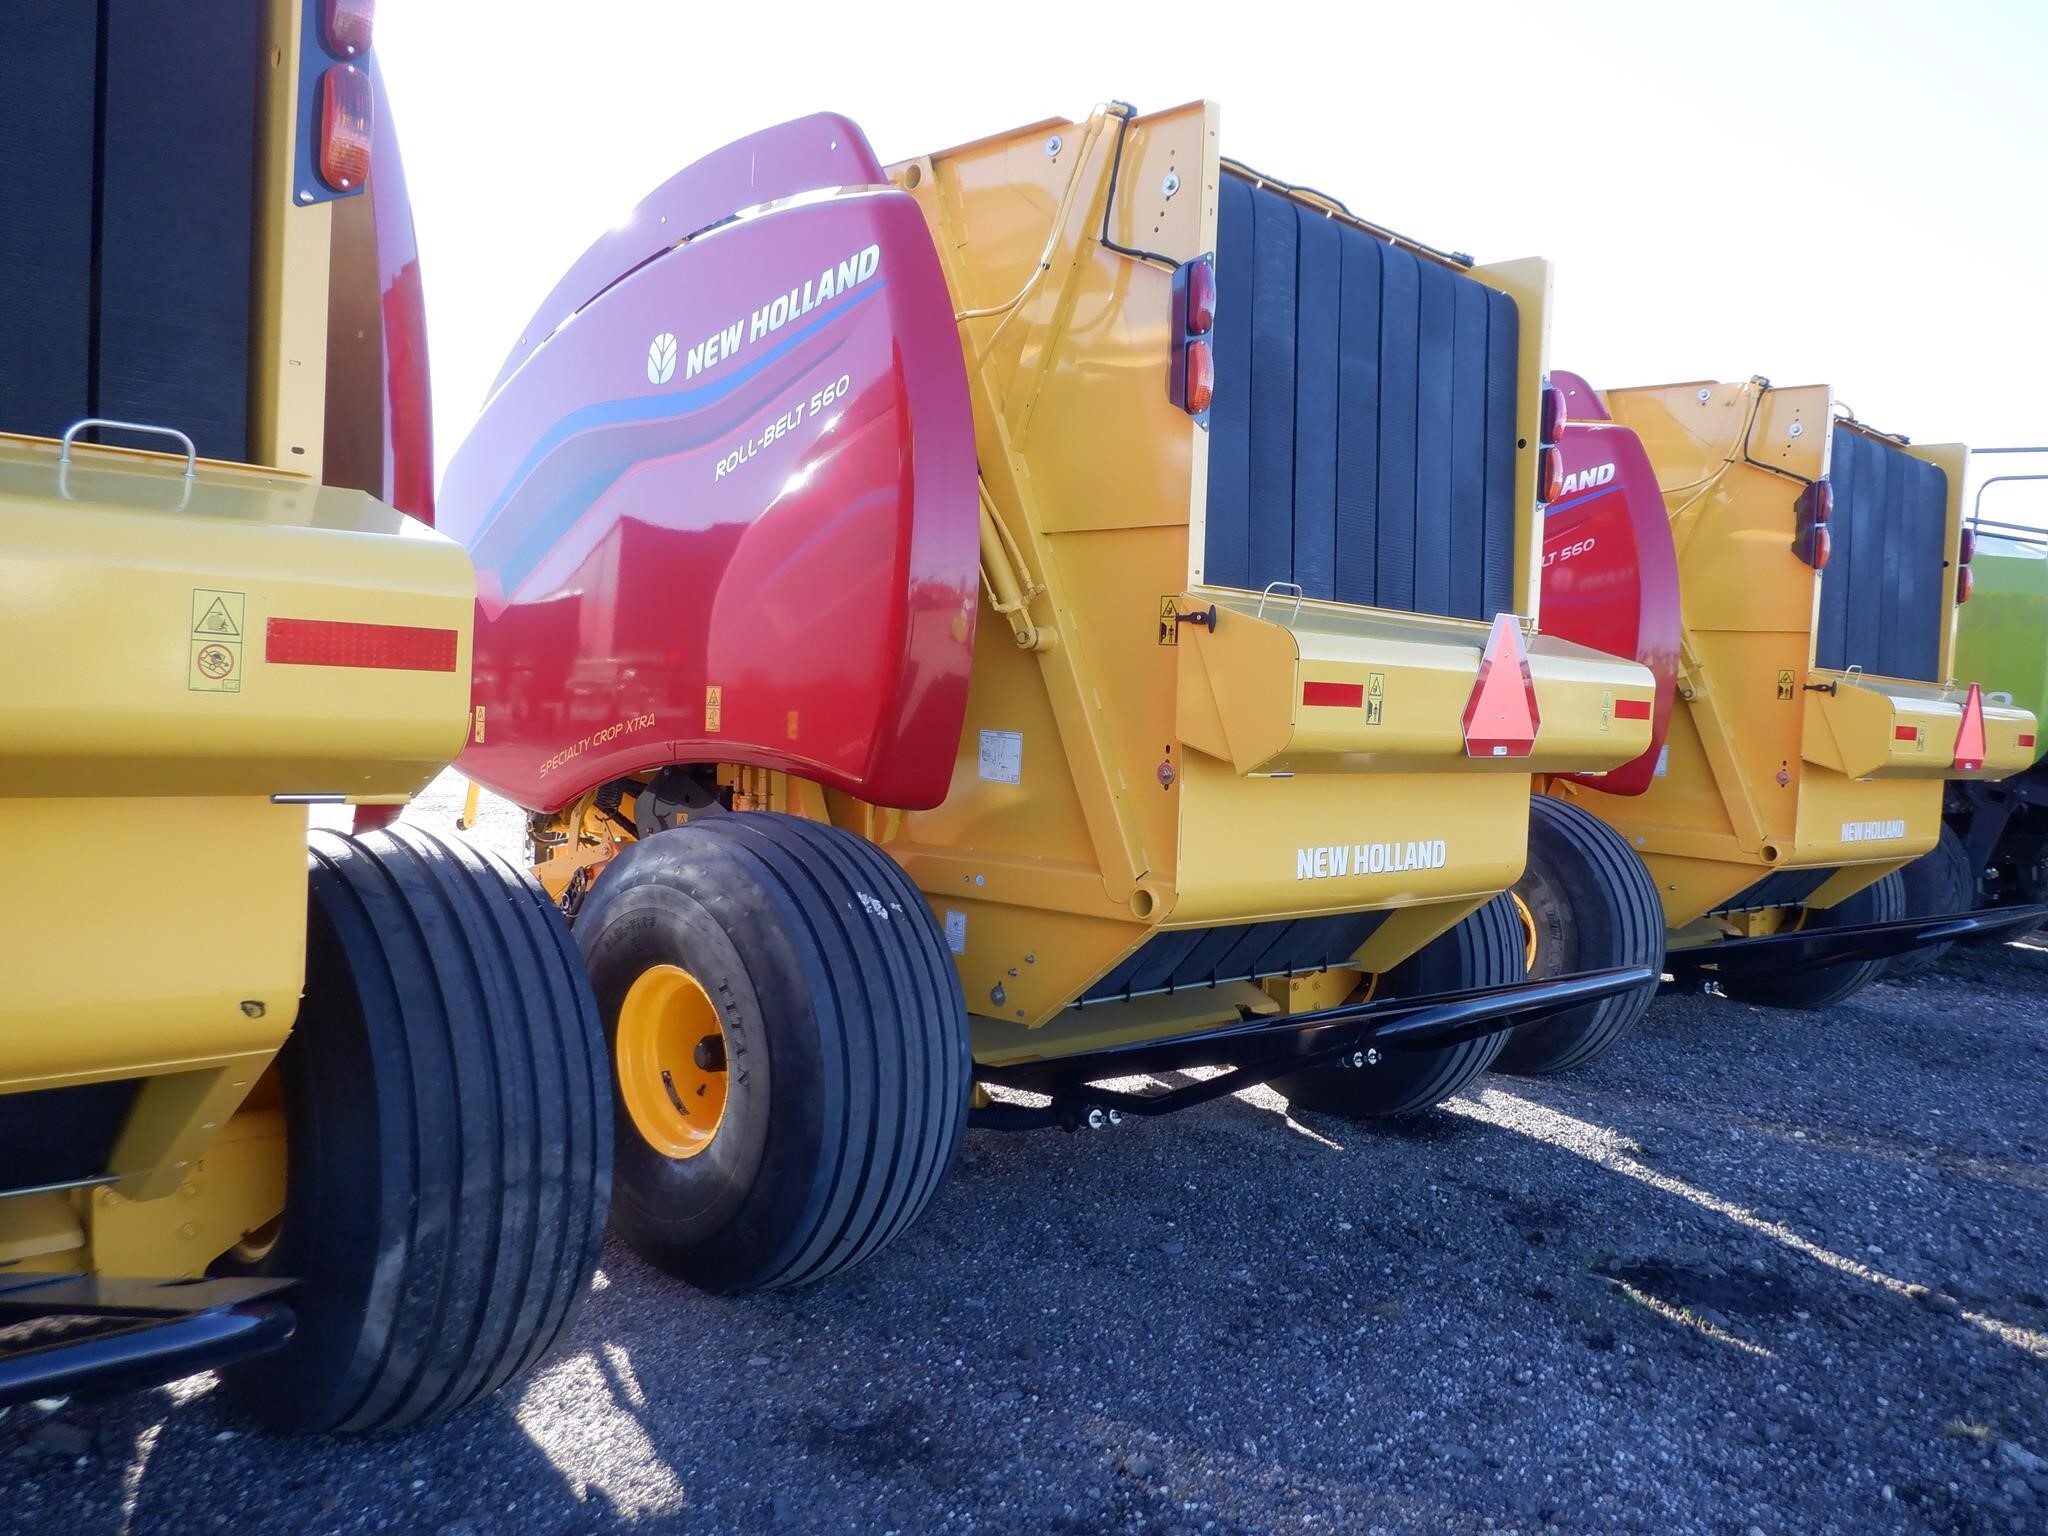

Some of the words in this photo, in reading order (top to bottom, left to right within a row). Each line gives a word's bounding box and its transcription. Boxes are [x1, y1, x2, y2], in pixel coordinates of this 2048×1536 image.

[686, 319, 745, 381] NEW
[749, 244, 881, 345] HOLLAND
[714, 401, 806, 482] ROLL-BELT
[809, 374, 850, 417] 560
[1560, 538, 1595, 561] 560
[540, 736, 591, 778] SPECIALTY
[593, 723, 624, 746] CROP
[625, 712, 656, 734] XTRA
[1297, 846, 1350, 880] NEW
[1353, 840, 1447, 875] HOLLAND
